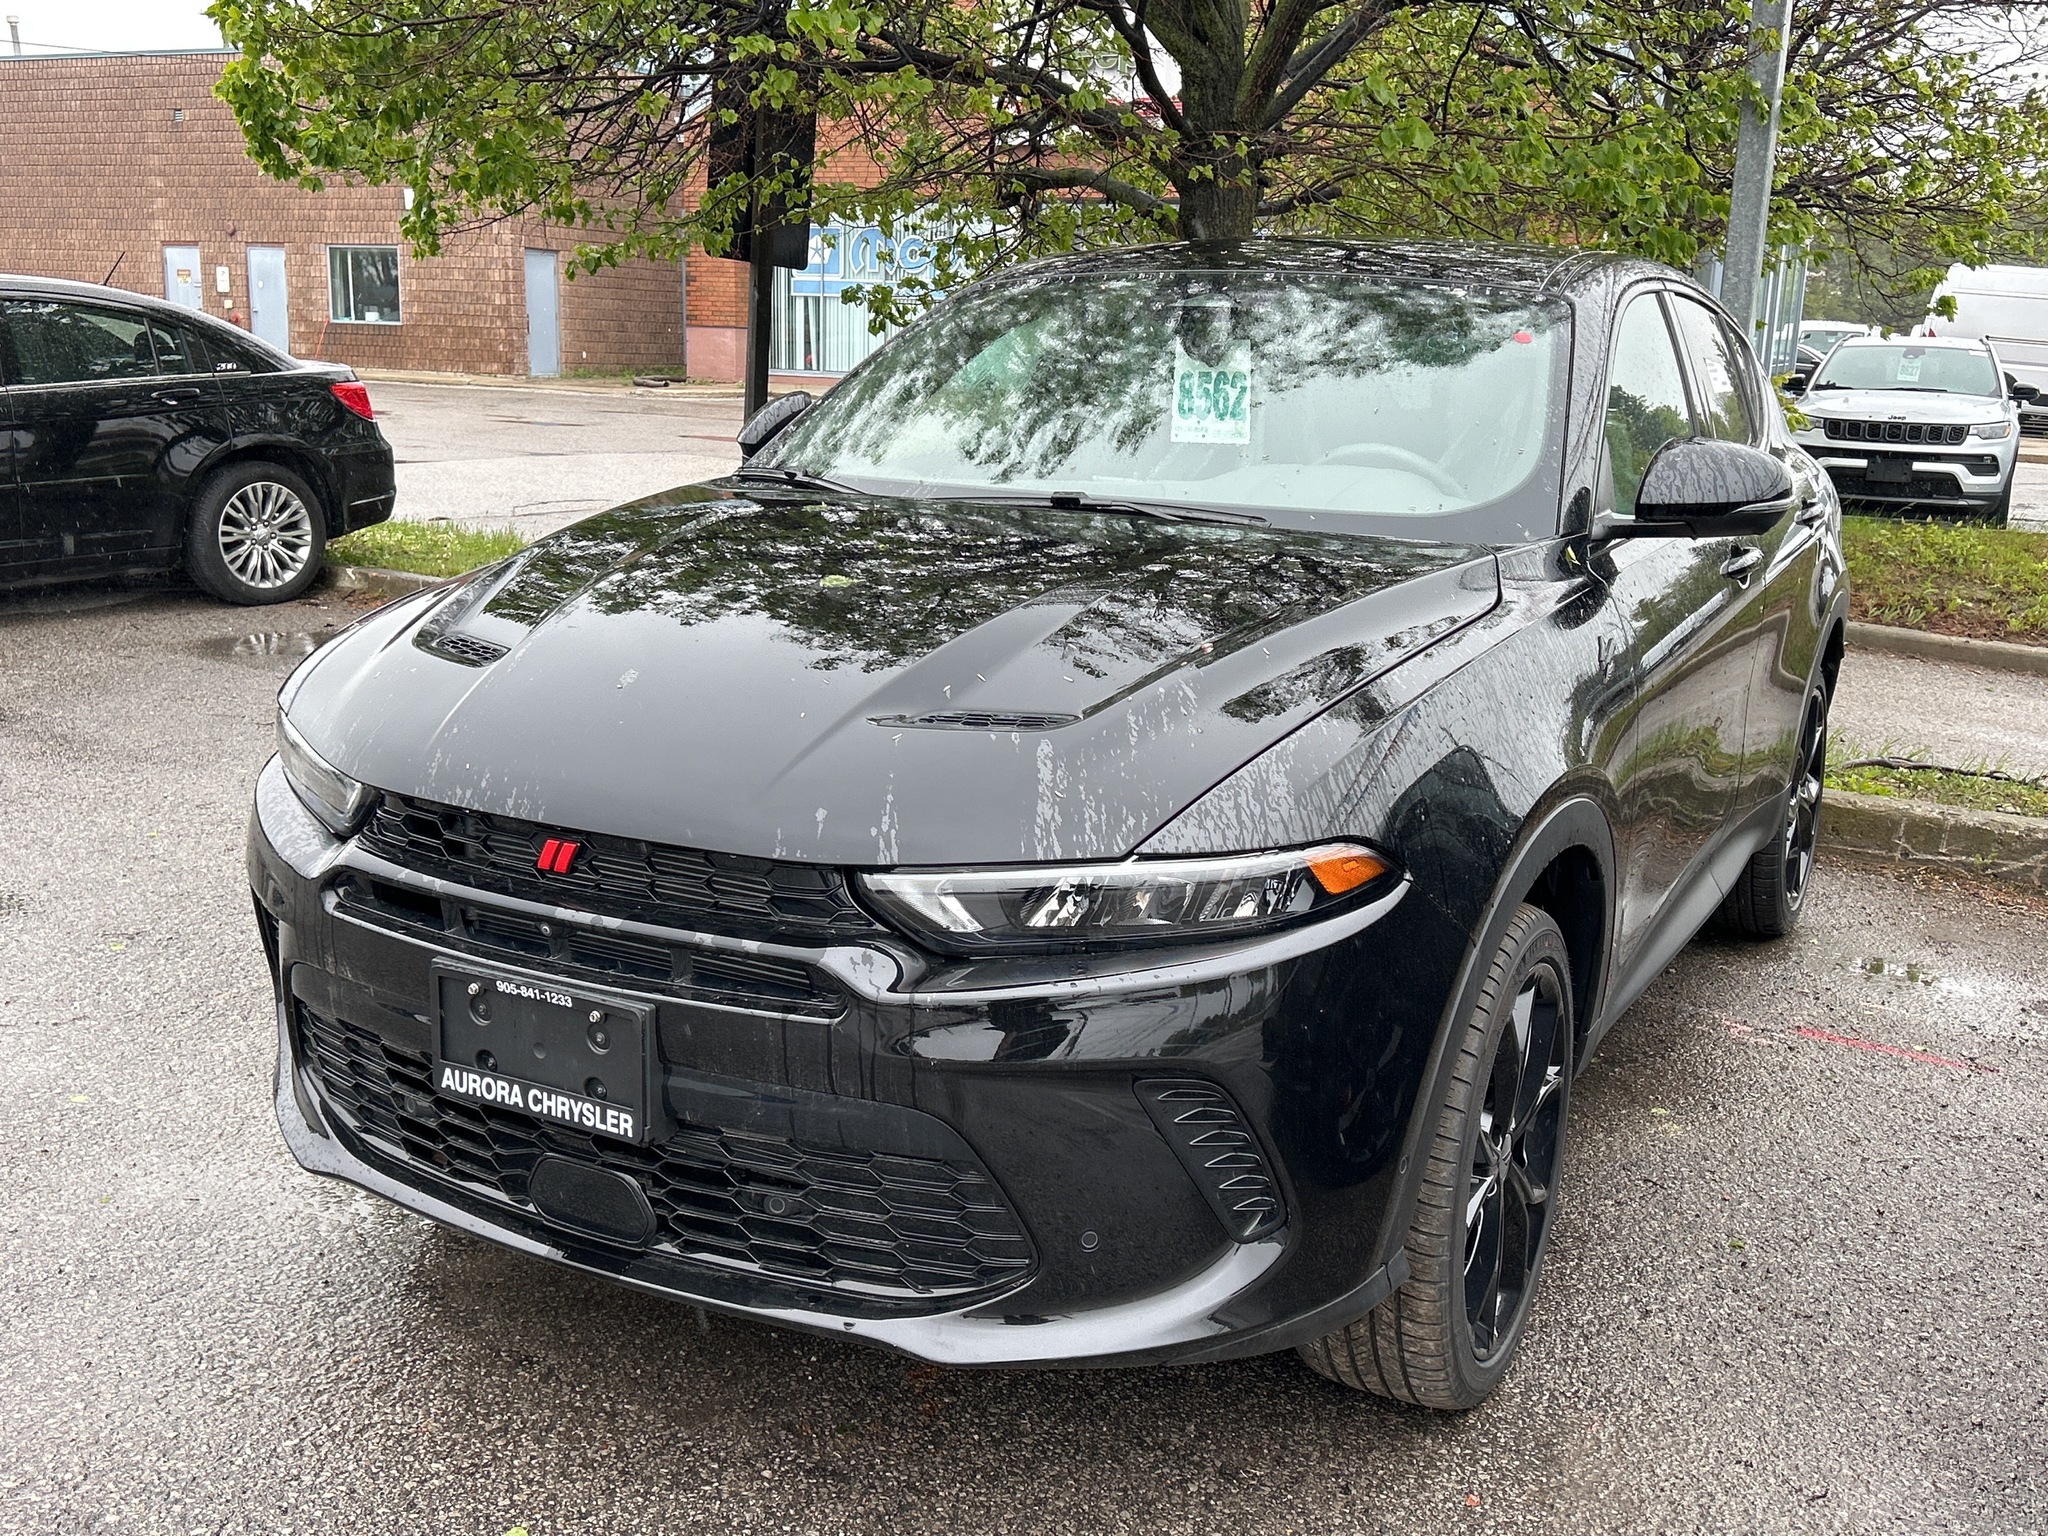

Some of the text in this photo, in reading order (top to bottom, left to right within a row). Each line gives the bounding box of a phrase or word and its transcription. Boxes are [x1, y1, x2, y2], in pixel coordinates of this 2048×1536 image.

[1178, 370, 1247, 421] 8562
[496, 980, 572, 1008] 905-841-1233
[441, 1067, 633, 1138] AURORA CHRYSLER
